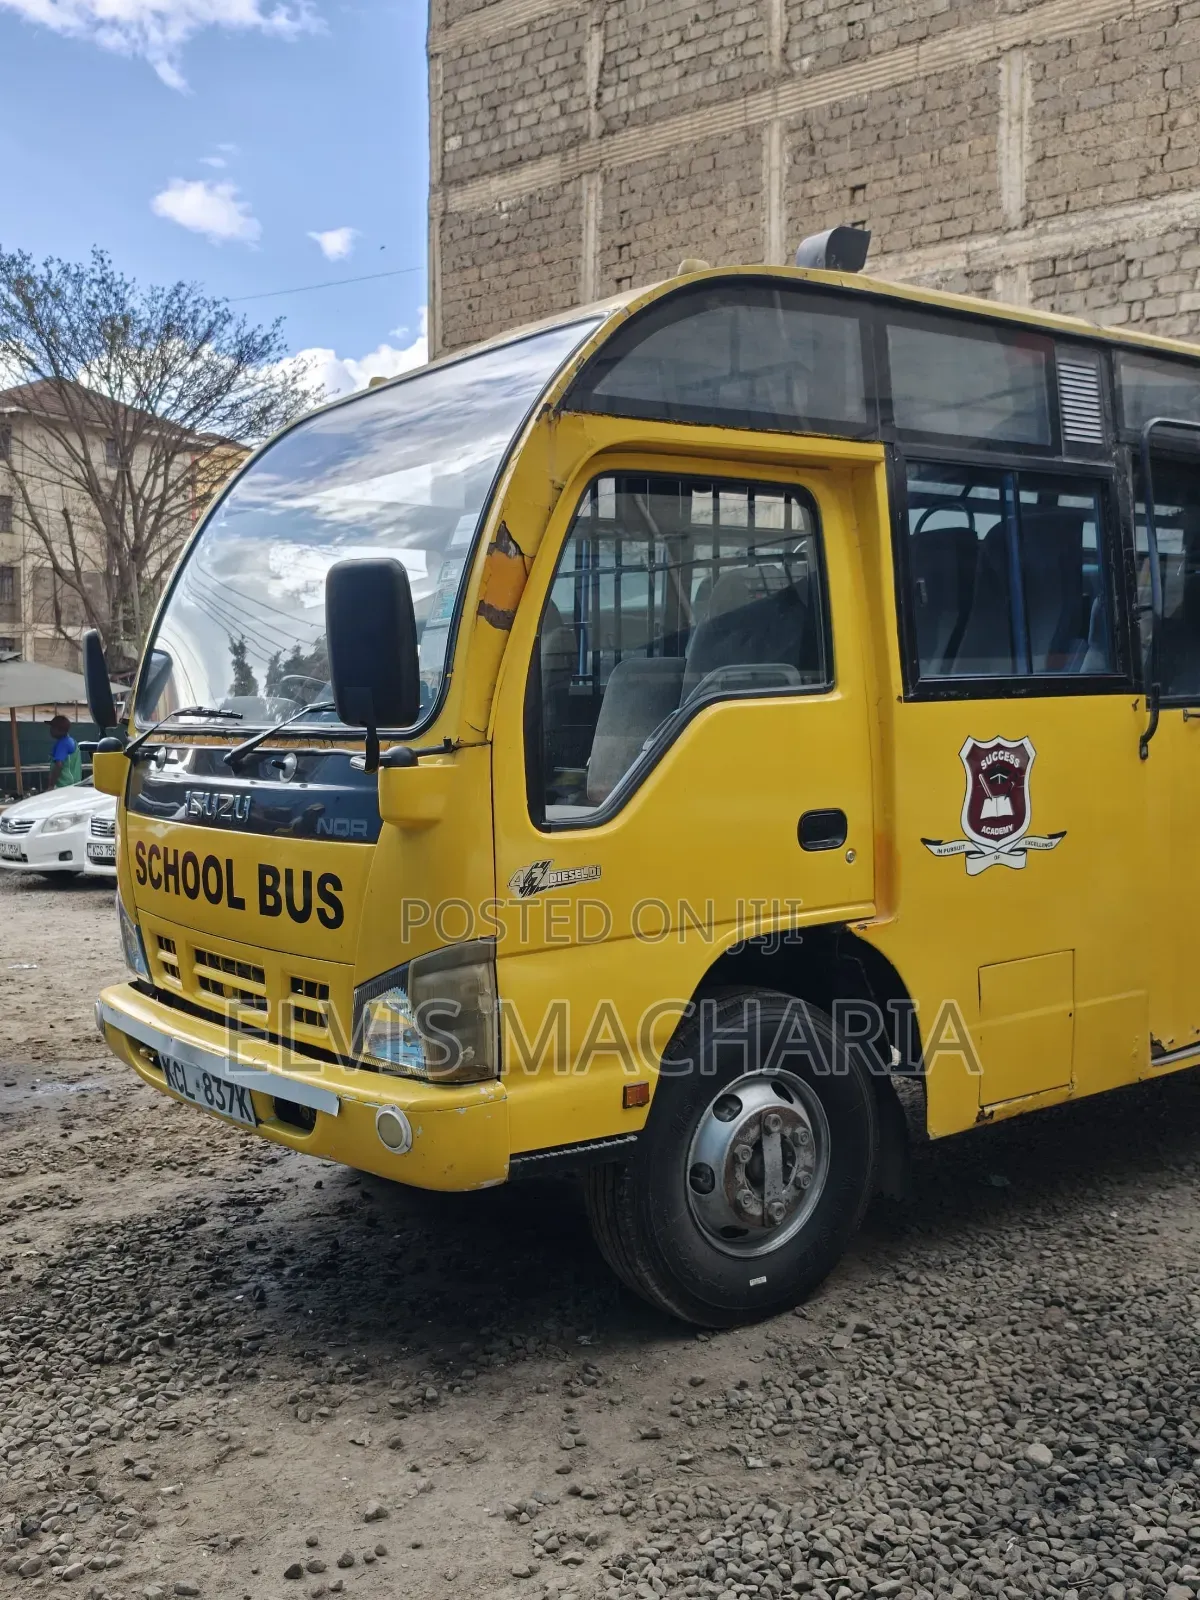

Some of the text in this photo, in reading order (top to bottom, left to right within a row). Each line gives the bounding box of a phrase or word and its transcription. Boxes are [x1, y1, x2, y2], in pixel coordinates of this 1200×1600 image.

[980, 750, 1020, 770] SUCCESS
[184, 790, 252, 822] ISUZU
[316, 818, 368, 837] NQR
[981, 823, 1014, 835] ACADEMY
[943, 844, 966, 854] PURSUIT
[1024, 840, 1054, 848] EXCELLENCE
[135, 840, 345, 930] SCHOOL BUS
[549, 867, 588, 884] DIESEL
[161, 1055, 253, 1122] KCL 837K
